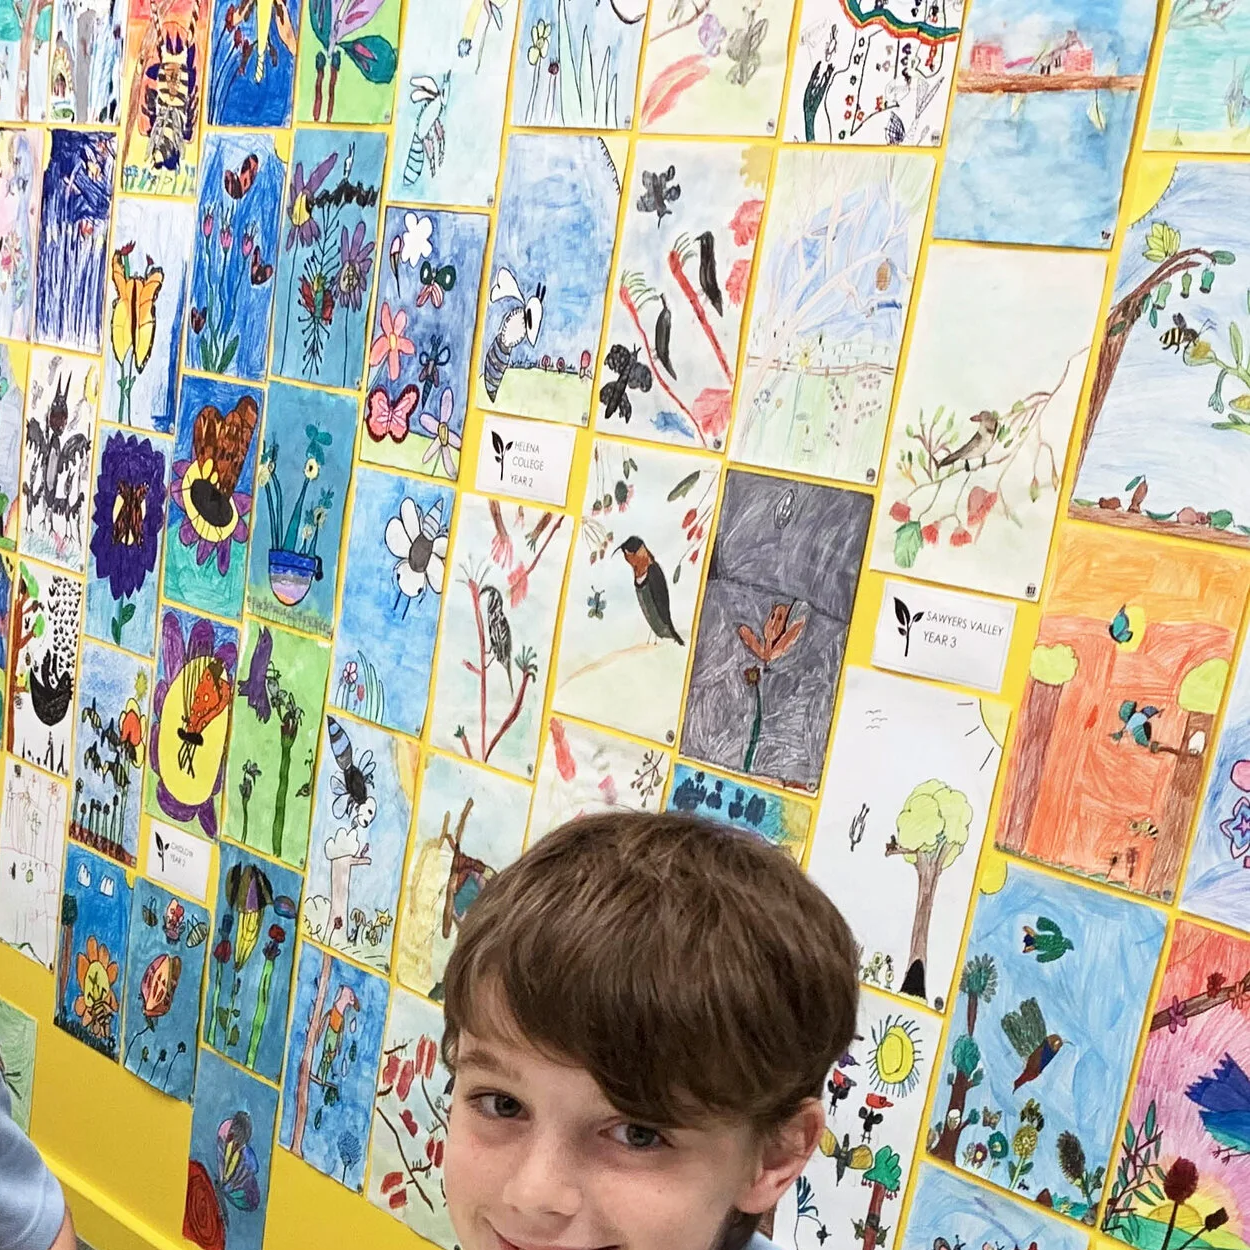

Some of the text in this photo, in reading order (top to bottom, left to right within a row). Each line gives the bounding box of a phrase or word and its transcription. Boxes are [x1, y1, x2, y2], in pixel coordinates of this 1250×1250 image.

[514, 441, 540, 454] HELENA
[512, 456, 544, 471] COLLEGE
[510, 474, 534, 488] YEAR 2
[926, 611, 1004, 637] SAWYERS VALLEY
[923, 631, 957, 648] YEAR 3
